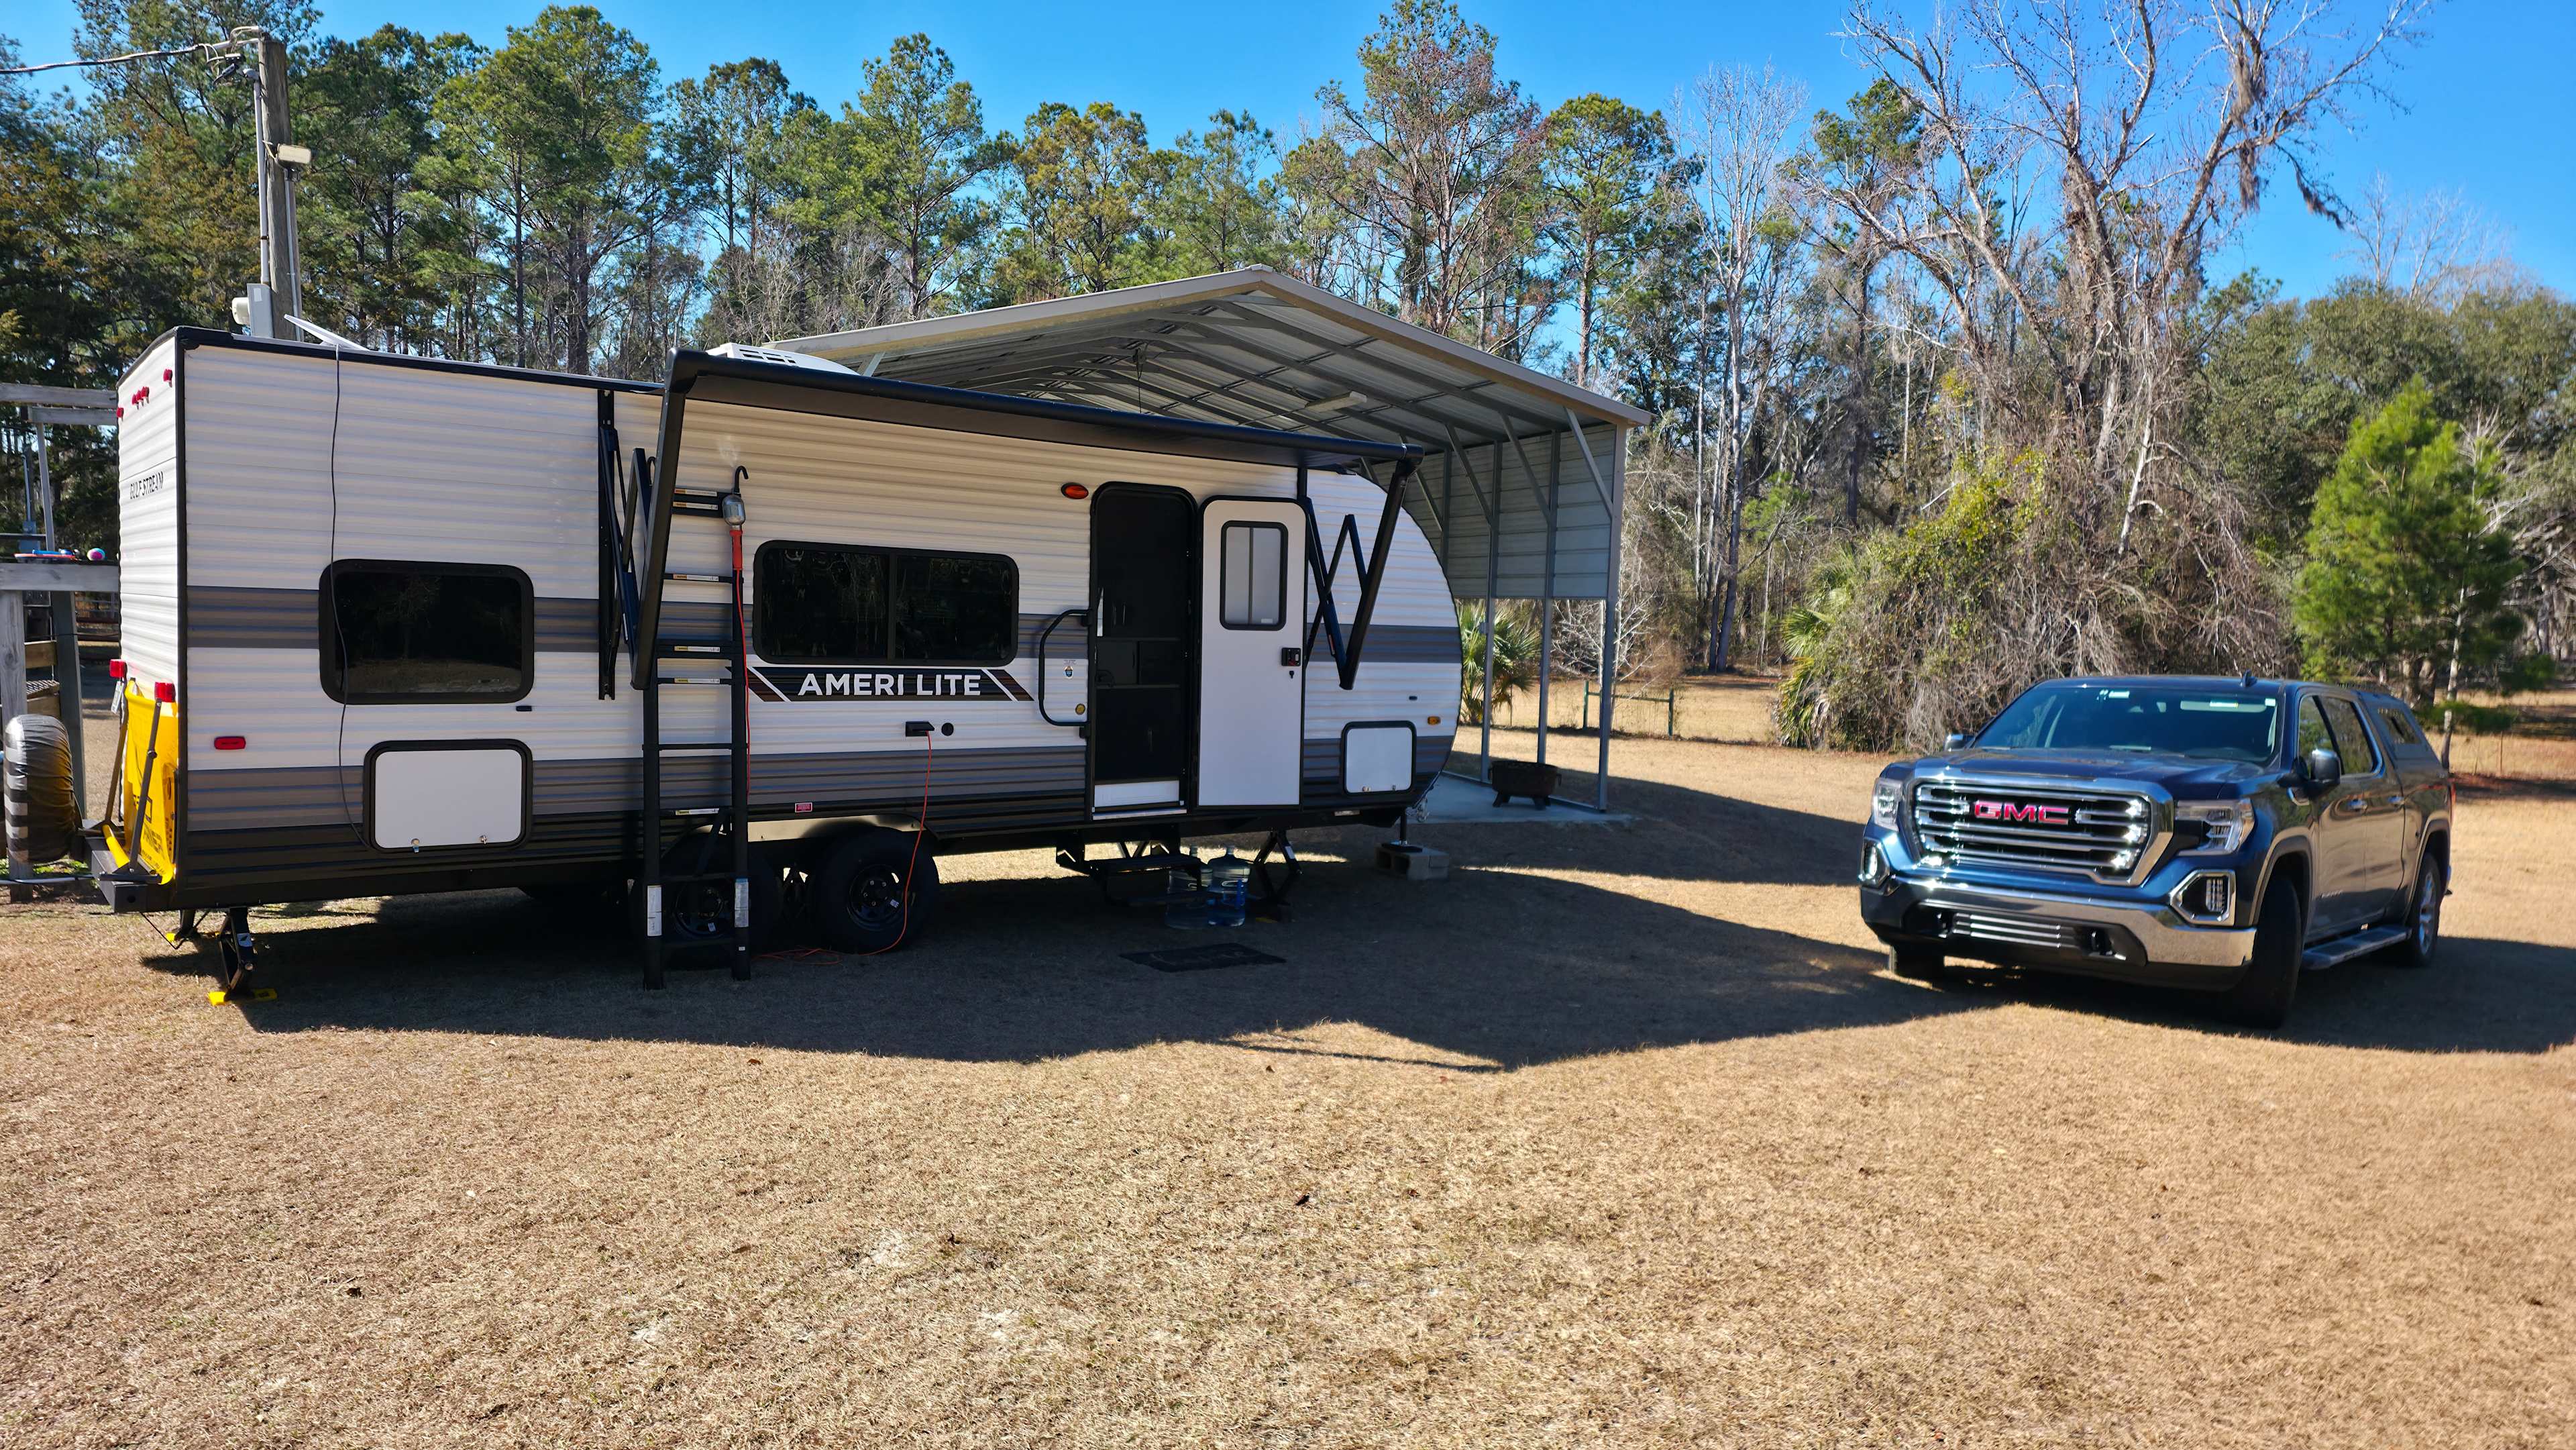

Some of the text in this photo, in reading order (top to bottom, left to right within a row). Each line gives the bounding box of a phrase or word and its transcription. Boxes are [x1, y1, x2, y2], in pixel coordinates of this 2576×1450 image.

[142, 471, 164, 495] STREAM
[798, 673, 981, 696] AMERI LITE
[1974, 800, 2069, 825] GMC
